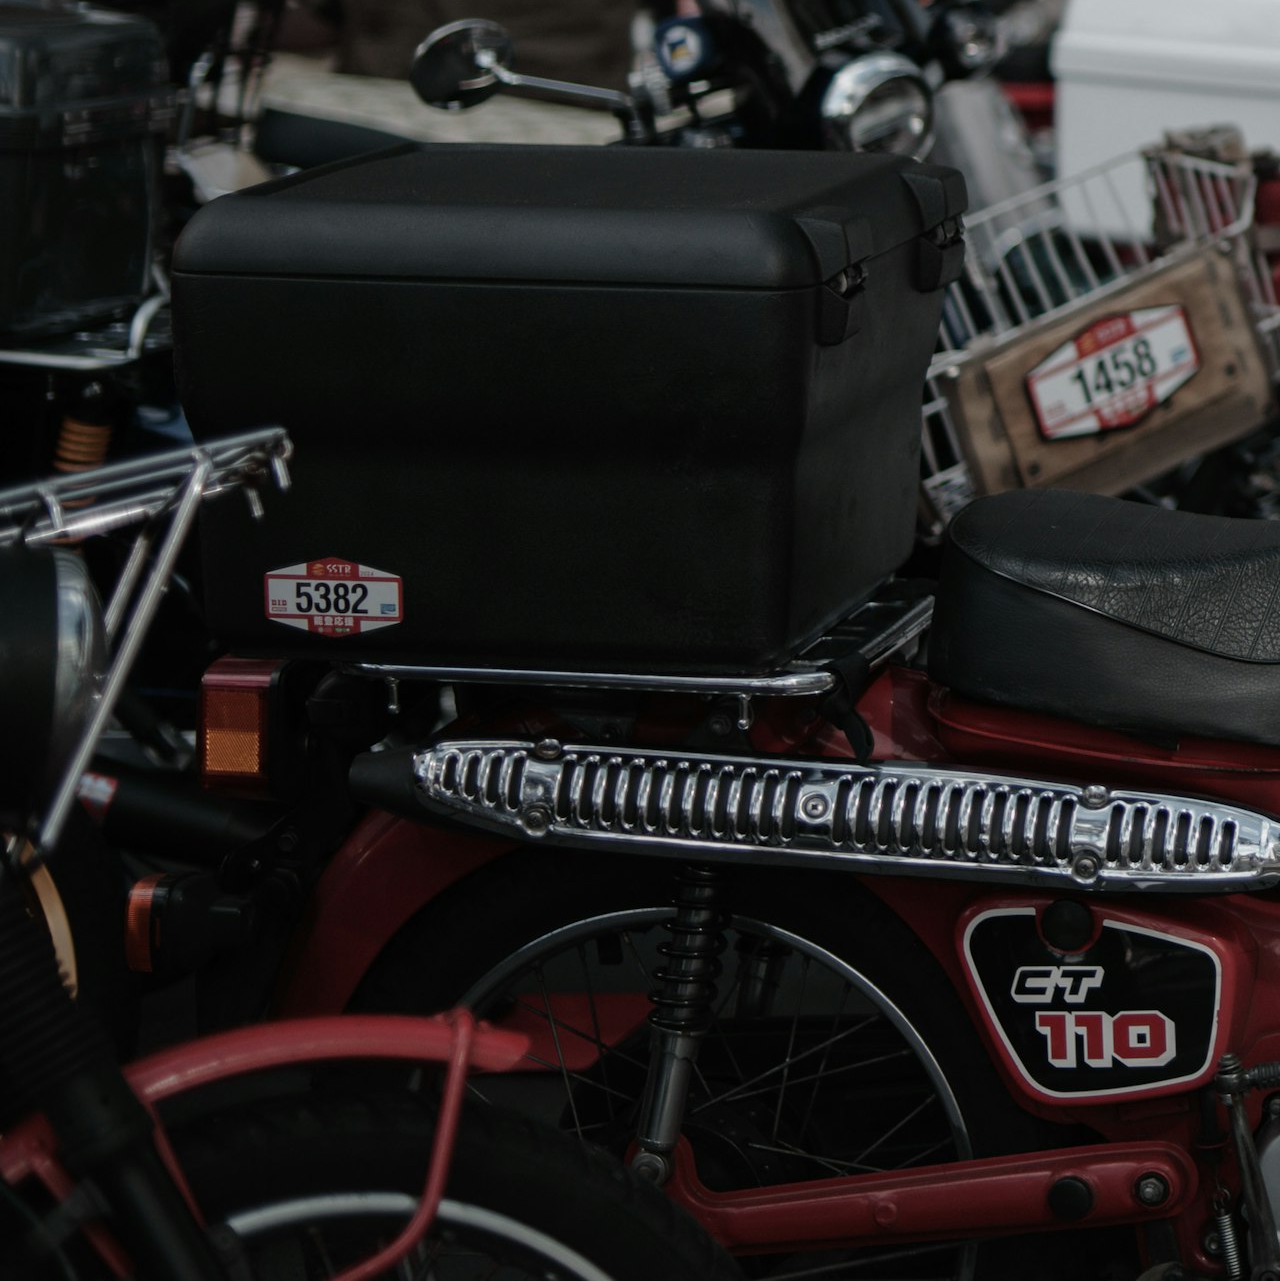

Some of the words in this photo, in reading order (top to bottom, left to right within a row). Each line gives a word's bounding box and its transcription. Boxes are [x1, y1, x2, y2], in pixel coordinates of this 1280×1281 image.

[1072, 338, 1156, 404] 1458
[326, 564, 352, 575] SSTR
[296, 582, 369, 614] 5382
[1010, 965, 1105, 1005] CT
[1034, 1009, 1176, 1067] 110
